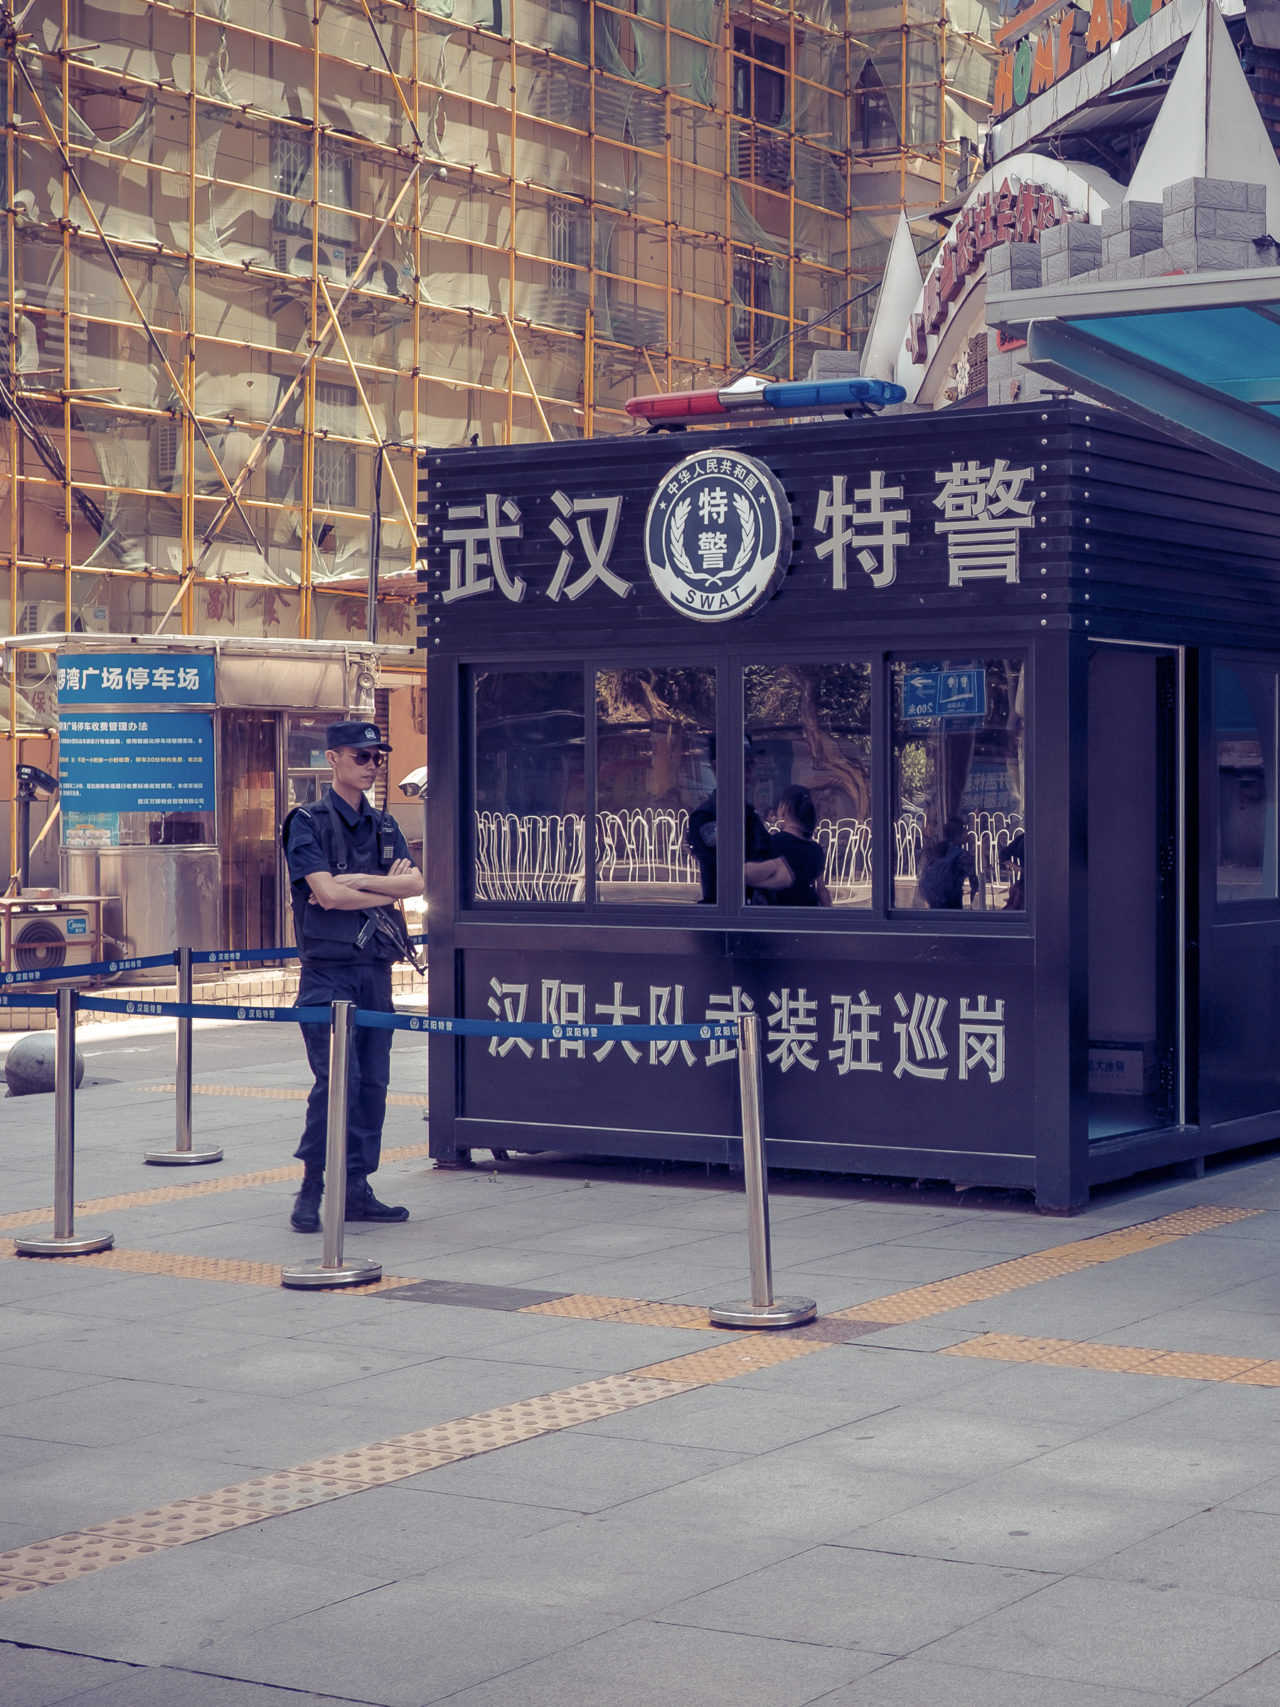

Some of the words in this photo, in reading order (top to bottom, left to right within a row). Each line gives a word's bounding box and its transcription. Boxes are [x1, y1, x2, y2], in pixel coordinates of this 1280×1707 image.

[992, 9, 1077, 117] HOME
[667, 459, 758, 495] 中华人民共和国
[442, 489, 634, 603] 武汉
[814, 458, 1036, 589] 特警
[698, 487, 728, 569] 特警
[685, 585, 742, 609] SWAT
[422, 1019, 453, 1031] 汉阳特警
[487, 975, 1006, 1083] 汉阳大队武装驻巡岗
[566, 1026, 598, 1038] 汉阳特警
